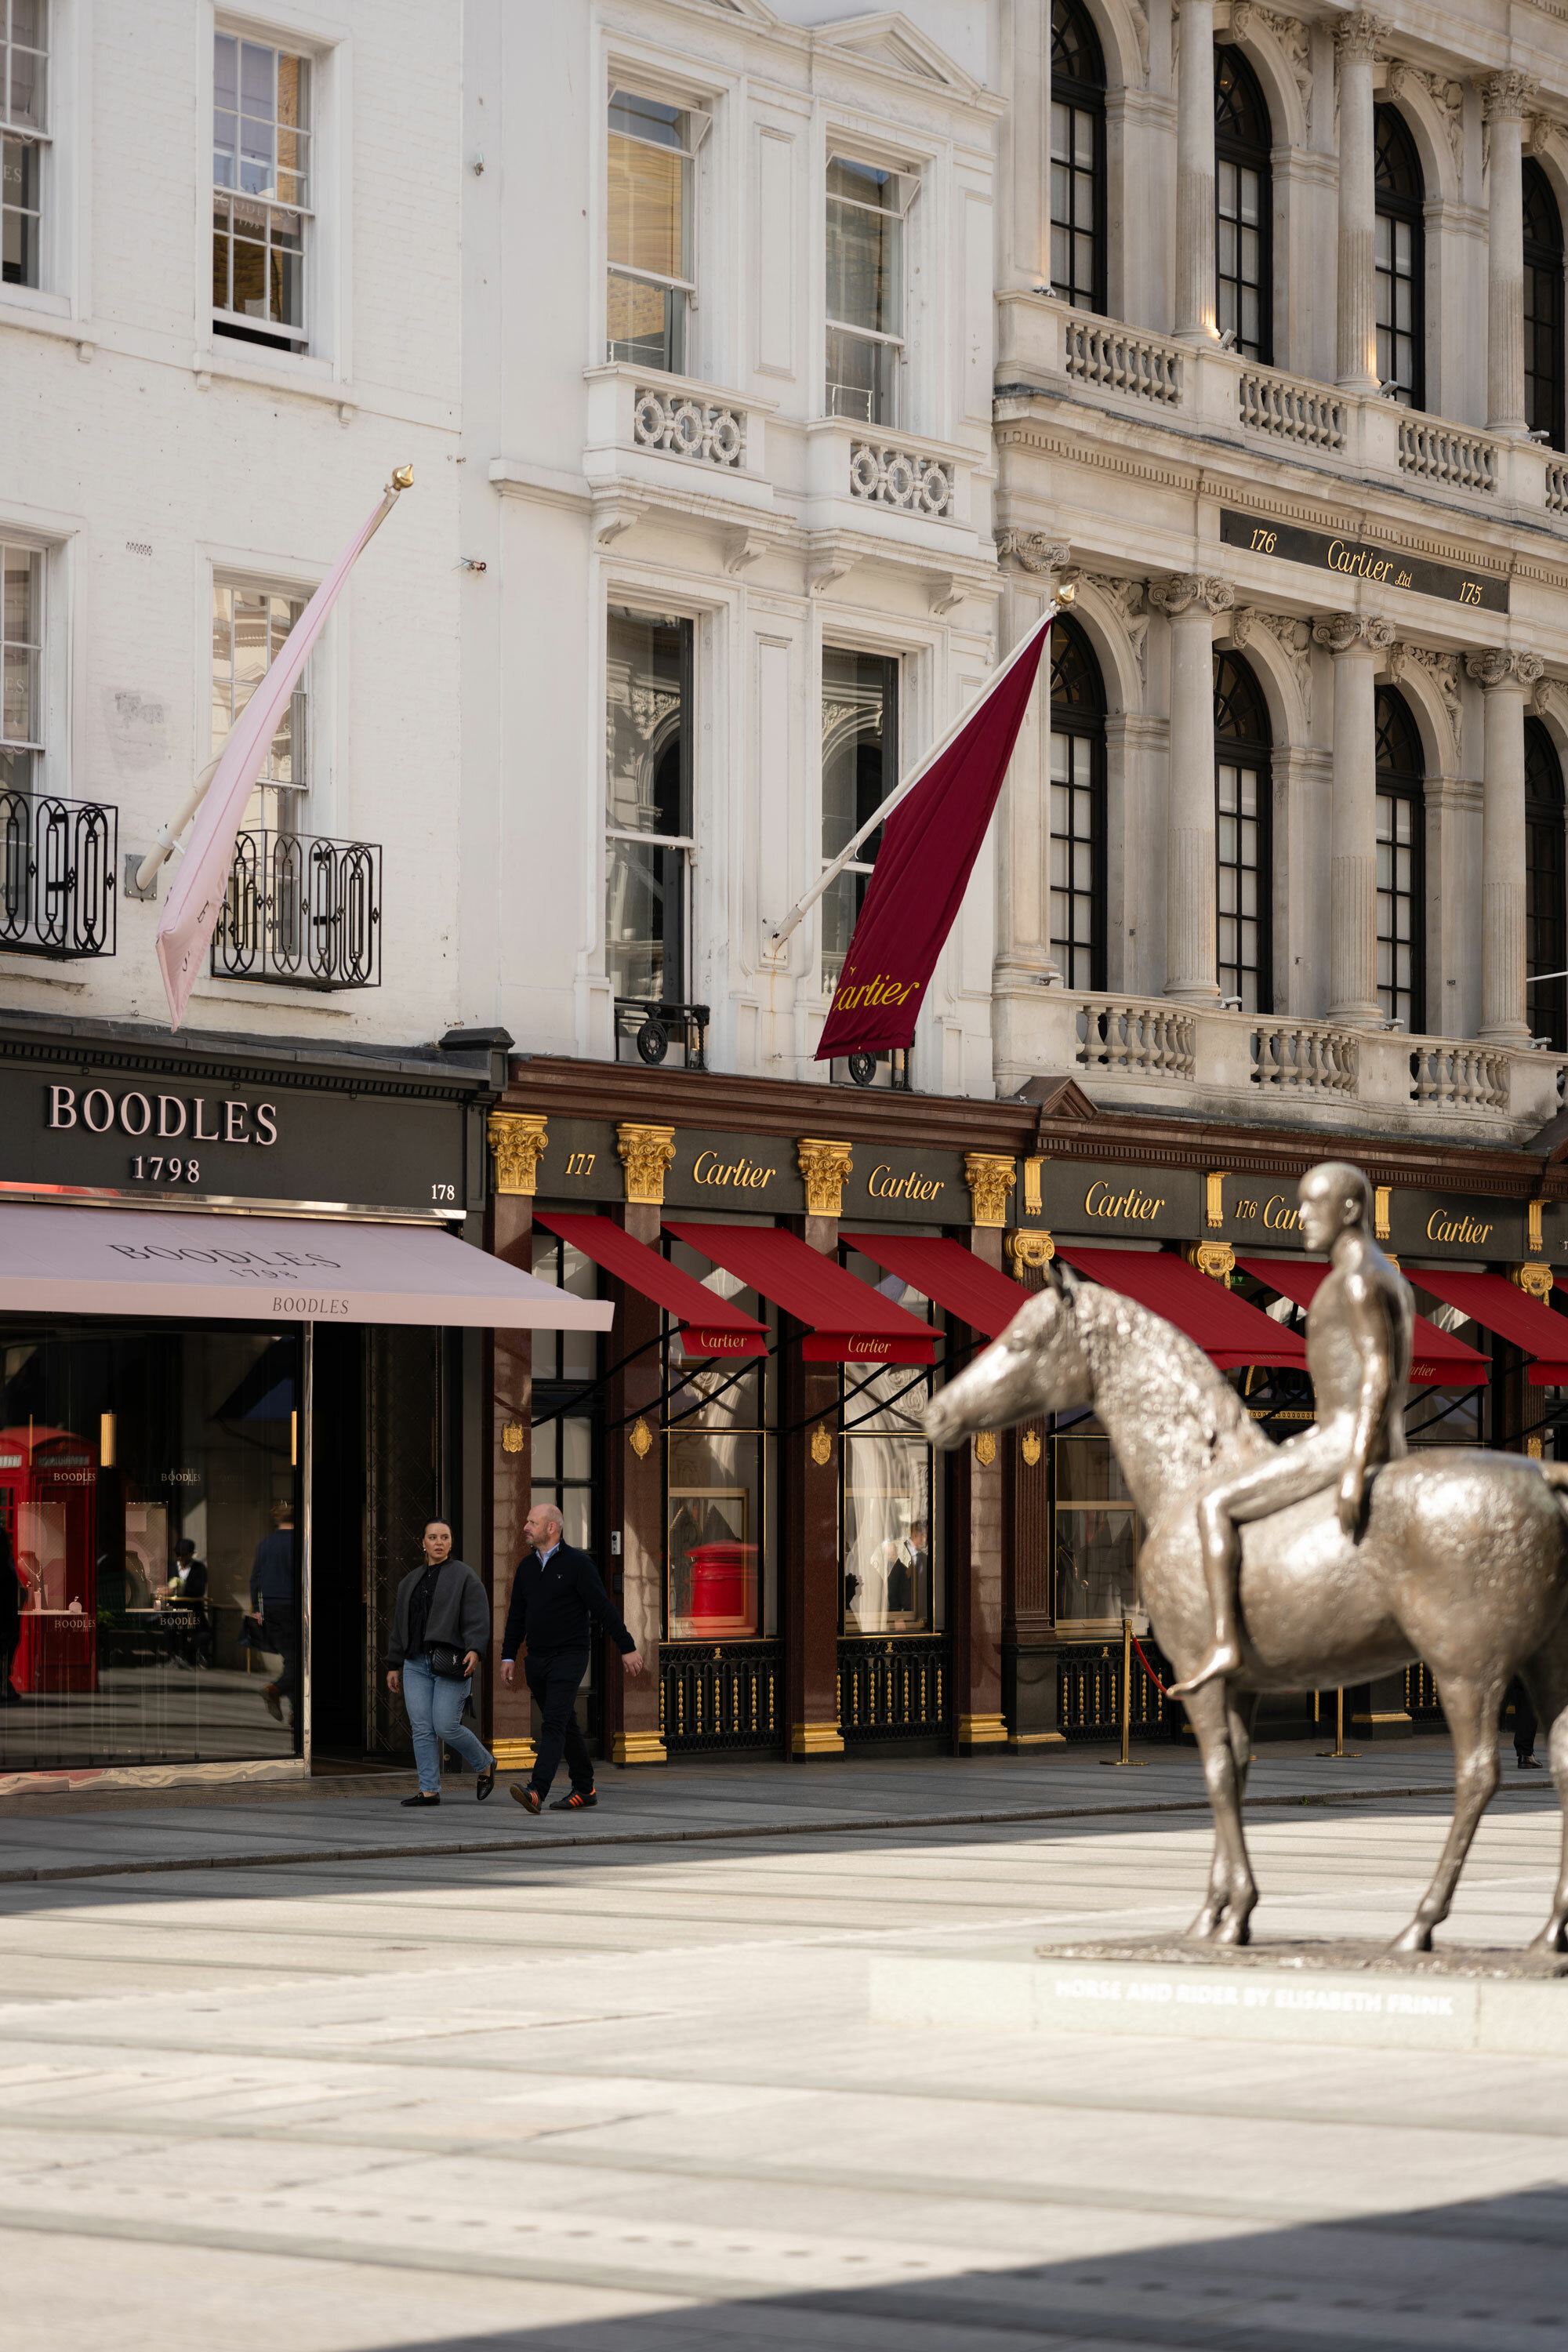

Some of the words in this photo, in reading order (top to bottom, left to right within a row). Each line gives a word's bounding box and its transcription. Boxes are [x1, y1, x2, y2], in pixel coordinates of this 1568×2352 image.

[1249, 528, 1277, 554] 176
[1327, 539, 1393, 582] Cartier
[1394, 570, 1413, 588] Ltd
[1458, 582, 1483, 605] 175
[49, 1085, 278, 1145] BOODLES
[134, 1156, 200, 1183] 1798
[565, 1153, 596, 1175] 177
[693, 1150, 776, 1188] Cartier
[431, 1184, 455, 1200] 178
[868, 1164, 944, 1200] Cartier
[1085, 1181, 1165, 1220] Cartier
[1235, 1200, 1258, 1218] 176
[1426, 1209, 1493, 1244] Cartier
[107, 1244, 341, 1269] BOODLES
[272, 1297, 350, 1315] BOODLES
[701, 1330, 747, 1348] Cartier
[848, 1334, 891, 1354] Cartier
[1410, 1363, 1436, 1377] artier
[53, 1472, 96, 1482] BOODLES
[161, 1473, 201, 1482] BOODLES
[54, 1619, 96, 1628] BOODLES
[160, 1616, 201, 1625] BOODLES
[1055, 1979, 1122, 2000] HORSE
[1126, 1982, 1172, 2002] AND
[1176, 1984, 1238, 2005] RIDER
[1243, 1987, 1272, 2008] BY
[1274, 1988, 1382, 2013] ELISABETH
[1386, 1994, 1454, 2015] FRINK
